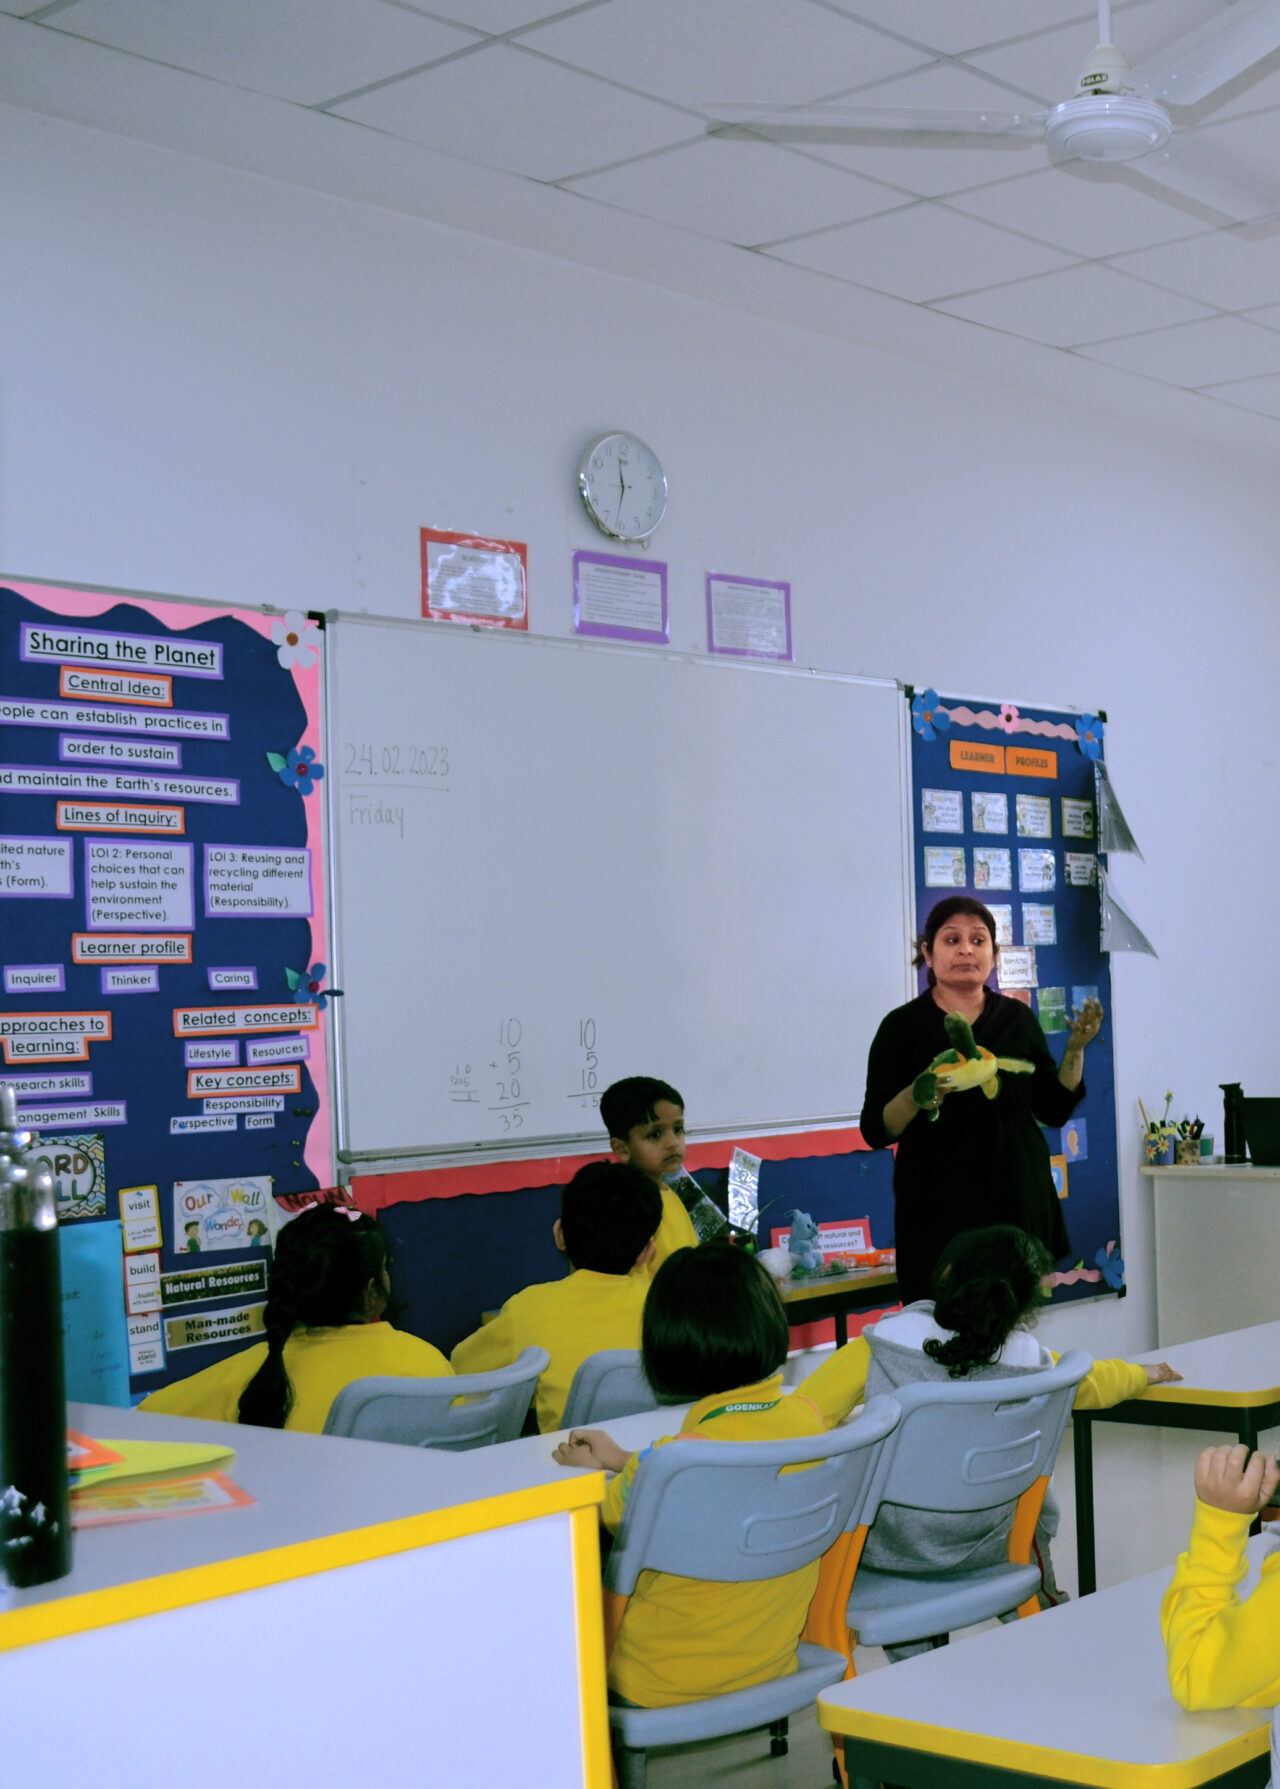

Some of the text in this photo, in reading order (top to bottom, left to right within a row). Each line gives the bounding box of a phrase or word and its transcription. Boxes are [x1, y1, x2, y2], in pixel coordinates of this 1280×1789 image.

[30, 632, 215, 666] Sharing the Planet
[68, 675, 165, 696] Central Idea:
[0, 705, 223, 732] ople can establish practices in
[68, 742, 174, 760] order to sustain
[18, 774, 81, 788] maintain
[86, 776, 108, 788] the
[116, 777, 160, 792] Earth's
[164, 783, 232, 797] resources.
[65, 807, 177, 827] Lines of Inquiry:
[350, 794, 405, 838] Friday
[27, 846, 65, 856] nature
[91, 848, 172, 860] LOI 2: Personal
[210, 852, 227, 862] LOI
[241, 853, 282, 866] Reusing
[285, 854, 305, 864] and
[91, 863, 185, 875] choices that can
[209, 868, 304, 879] recycling different
[6, 875, 48, 888] (Form).
[91, 879, 178, 892] help sustain the
[210, 882, 253, 892] material
[91, 895, 162, 904] environment
[210, 897, 291, 909] (Responsibility).
[92, 910, 169, 922] (Perspective).
[81, 940, 185, 957] Learner profile
[11, 974, 56, 986] Inquirer
[111, 975, 151, 985] Thinker
[215, 974, 250, 985] Caring
[90, 1018, 104, 1031] to
[183, 1010, 312, 1026] Related concepts:
[500, 1018, 522, 1047] 10
[580, 1018, 596, 1050] 10
[11, 1040, 80, 1055] learning:
[189, 1044, 304, 1061] Lifestyle Resources
[507, 1051, 521, 1075] 5
[586, 1052, 598, 1070] 5
[59, 1078, 86, 1089] skills
[196, 1072, 295, 1089] Key concepts:
[581, 1069, 597, 1090] 10
[497, 1078, 521, 1100] 20
[205, 1097, 282, 1110] Responsibility
[19, 1106, 121, 1123] anagement Skills
[247, 1115, 273, 1126] Form
[128, 1200, 151, 1210] visit
[185, 1192, 212, 1210] Our
[230, 1188, 260, 1207] Wall
[205, 1216, 243, 1234] Wonder
[130, 1263, 156, 1276] build
[165, 1271, 259, 1295] Natural Resources
[129, 1322, 159, 1336] stand
[185, 1311, 250, 1331] Man-made
[186, 1324, 251, 1343] Resources
